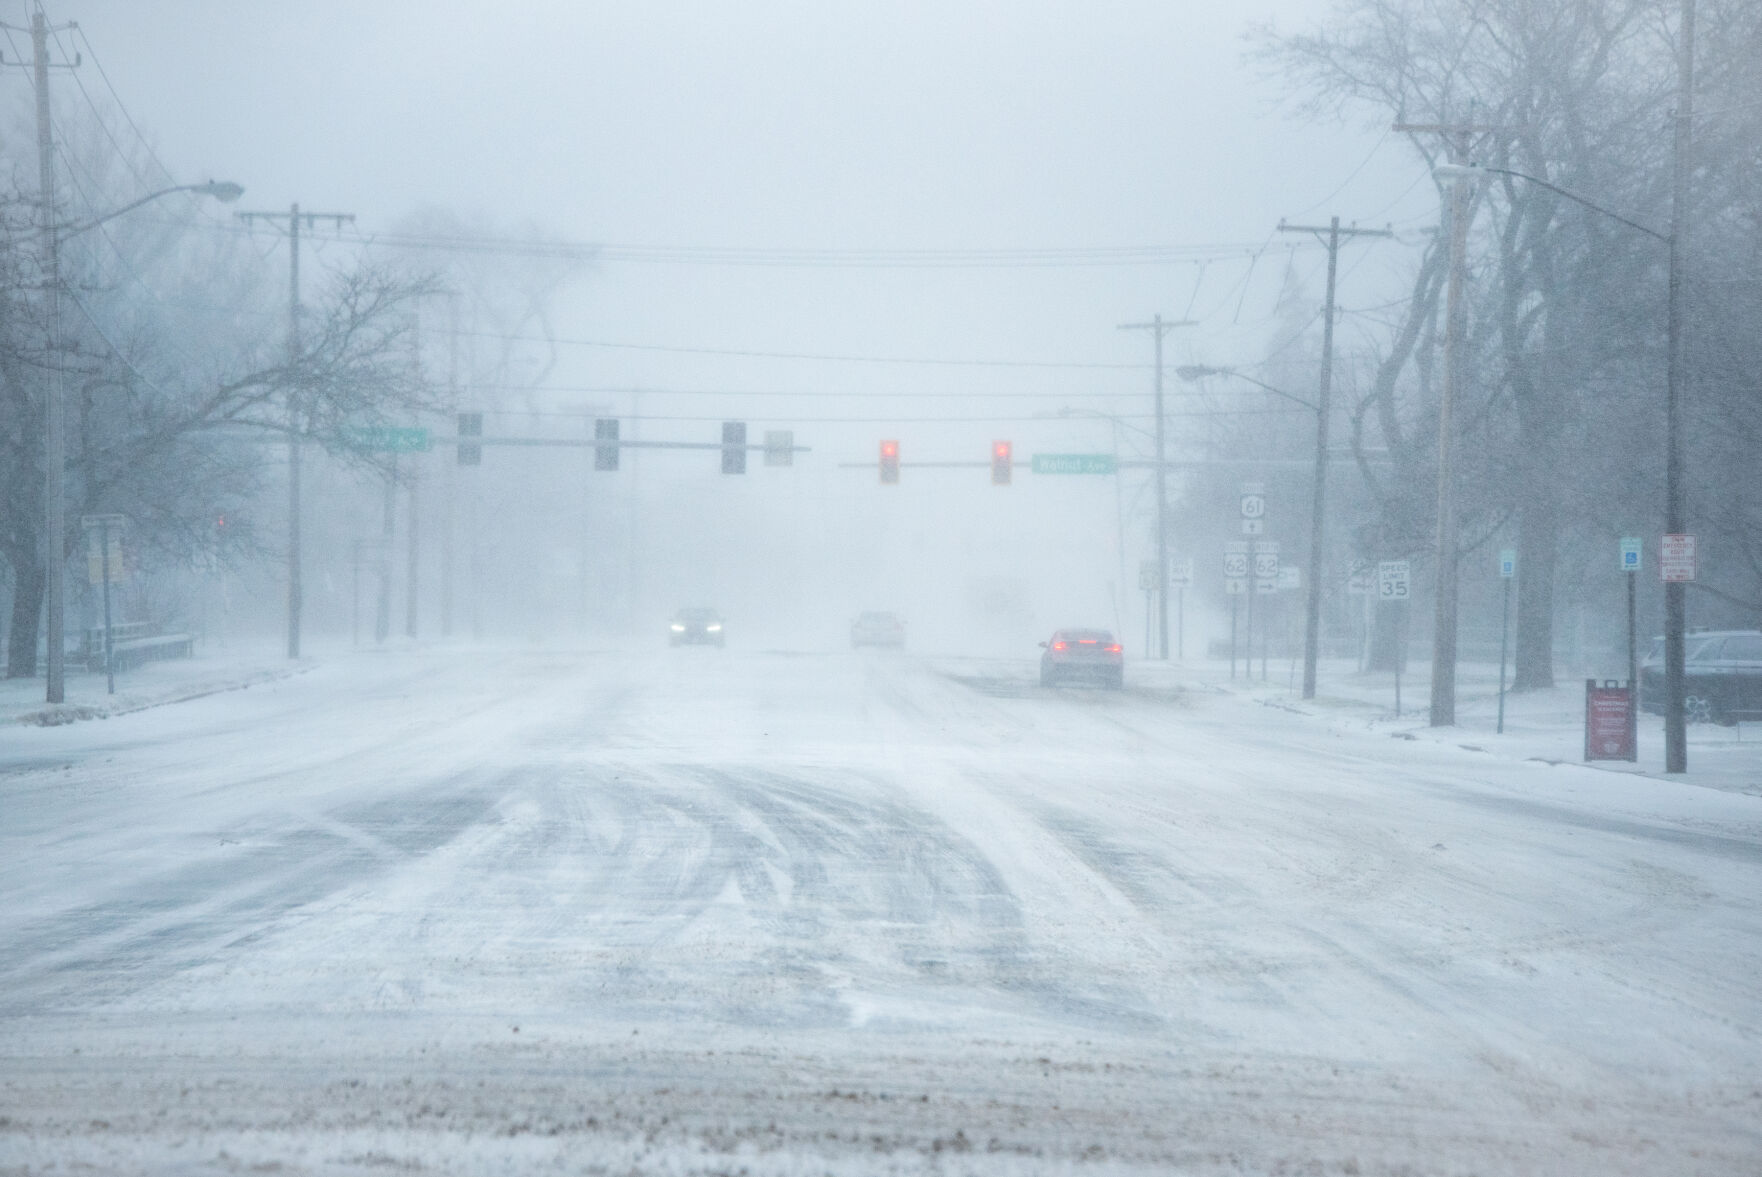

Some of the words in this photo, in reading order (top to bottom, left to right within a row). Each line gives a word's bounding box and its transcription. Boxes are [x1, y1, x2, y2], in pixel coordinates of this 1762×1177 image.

[1040, 456, 1082, 472] Walnut
[1246, 500, 1260, 514] 61
[1226, 559, 1245, 573] 62
[1257, 559, 1276, 573] 62
[1381, 564, 1409, 572] SPEED
[1383, 572, 1405, 580] LIMIT
[1382, 581, 1408, 596] 35
